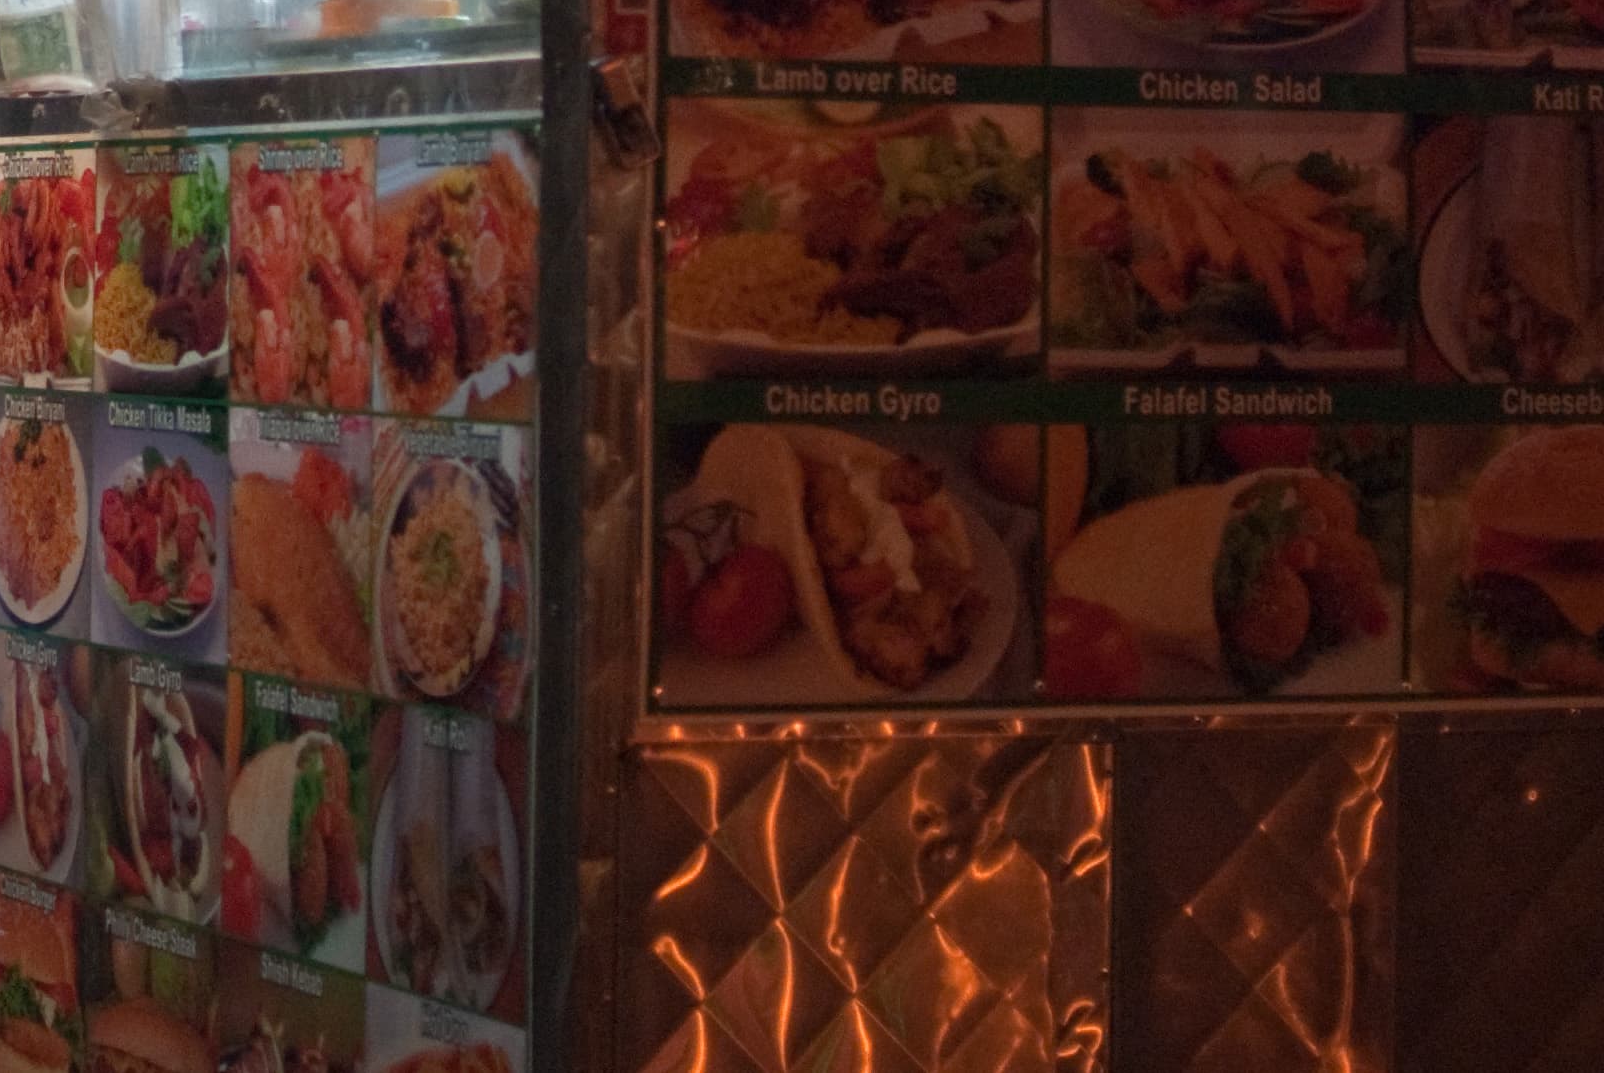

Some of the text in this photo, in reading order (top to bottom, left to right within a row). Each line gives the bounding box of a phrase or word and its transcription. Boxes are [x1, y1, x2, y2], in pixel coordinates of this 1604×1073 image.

[756, 62, 957, 95] Lamb over Rice
[1139, 71, 1322, 103] Chicken Salad
[1533, 83, 1580, 111] Kati
[4, 393, 66, 422] Chicken Biryani
[766, 384, 941, 422] Chicken Gyro
[1124, 386, 1333, 415] Falafel Sandwich
[1503, 387, 1604, 415] Cheeseb
[108, 401, 212, 433] Chicken Tikka Masala
[5, 632, 57, 669] Chicken Gyro
[129, 657, 182, 694] Lamb Gyro
[255, 679, 288, 712] Falafel
[133, 917, 167, 951] Cheese
